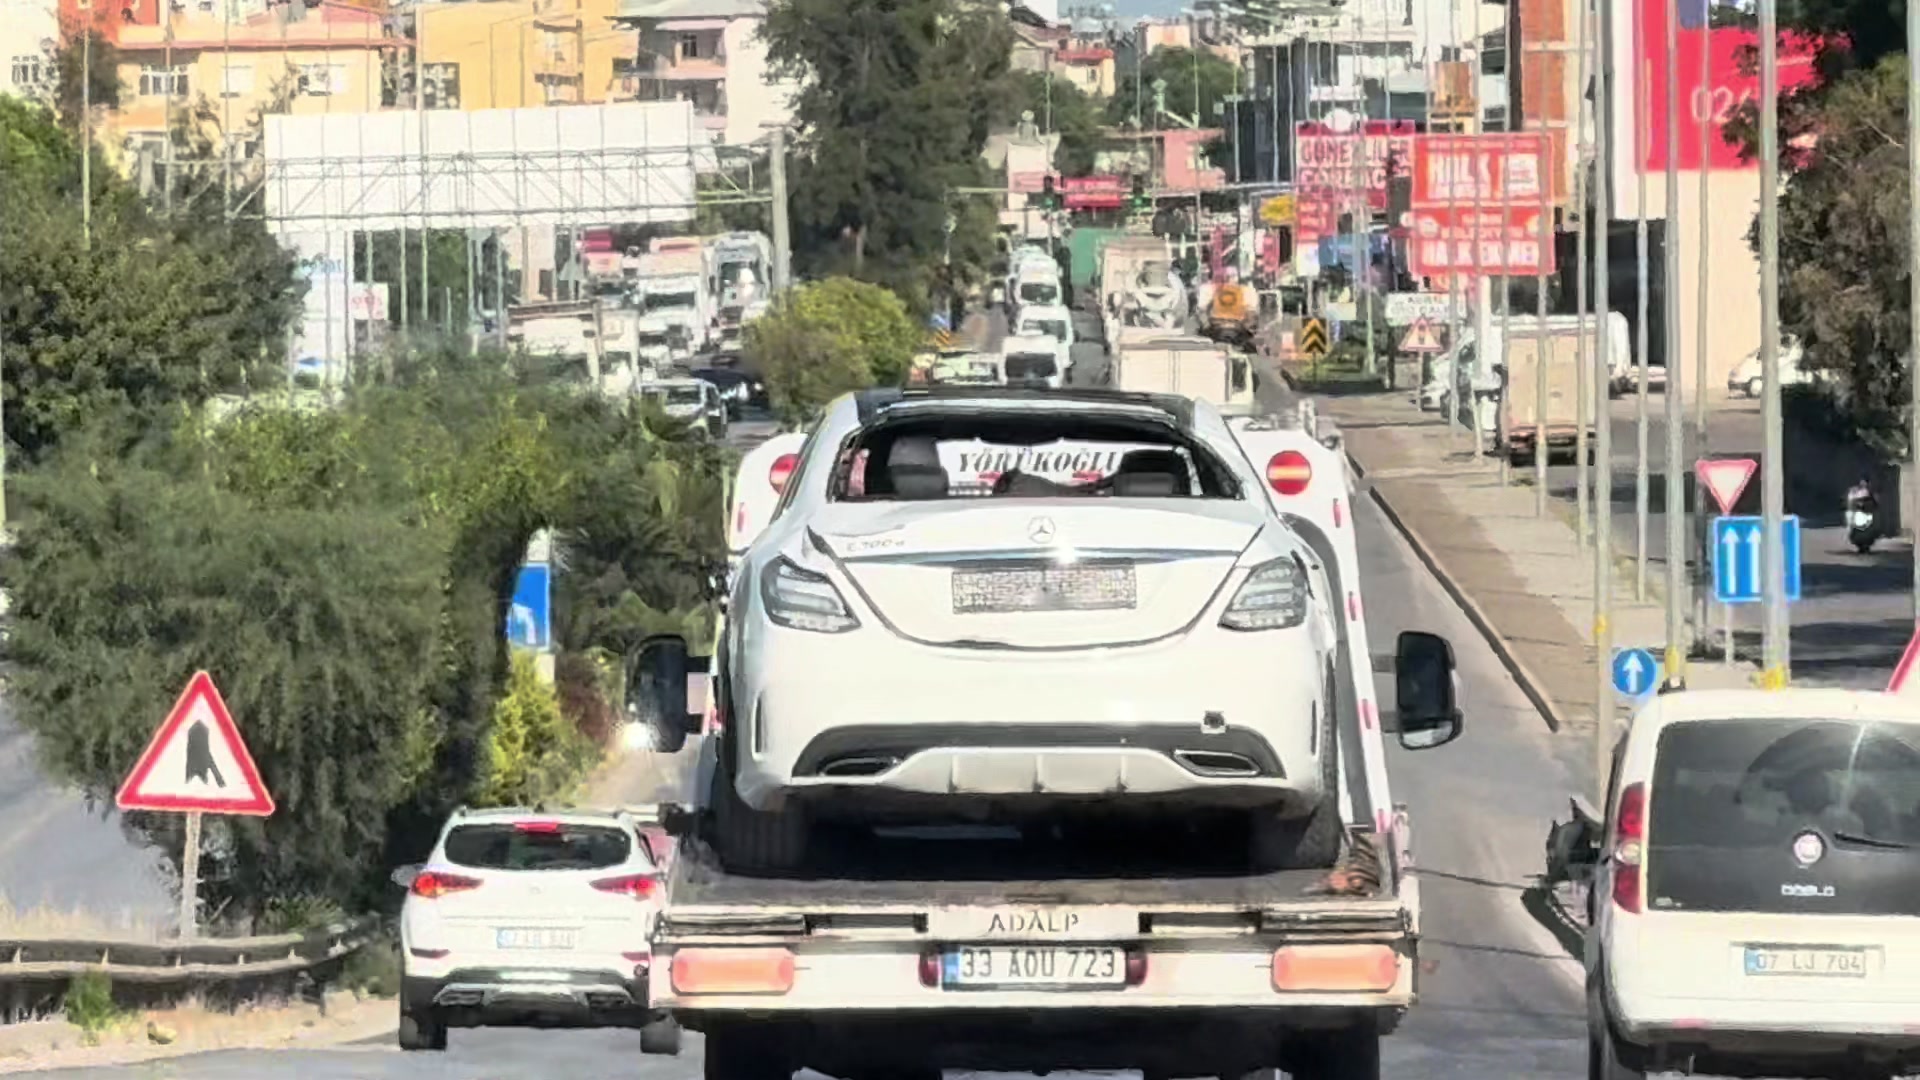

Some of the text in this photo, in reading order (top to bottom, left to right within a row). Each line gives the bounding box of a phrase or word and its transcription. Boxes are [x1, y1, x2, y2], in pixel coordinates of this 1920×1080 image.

[988, 911, 1079, 933] ADALP
[962, 949, 992, 977] 33
[1066, 949, 1115, 977] 723
[1755, 954, 1779, 969] 07
[1826, 954, 1861, 970] 704
